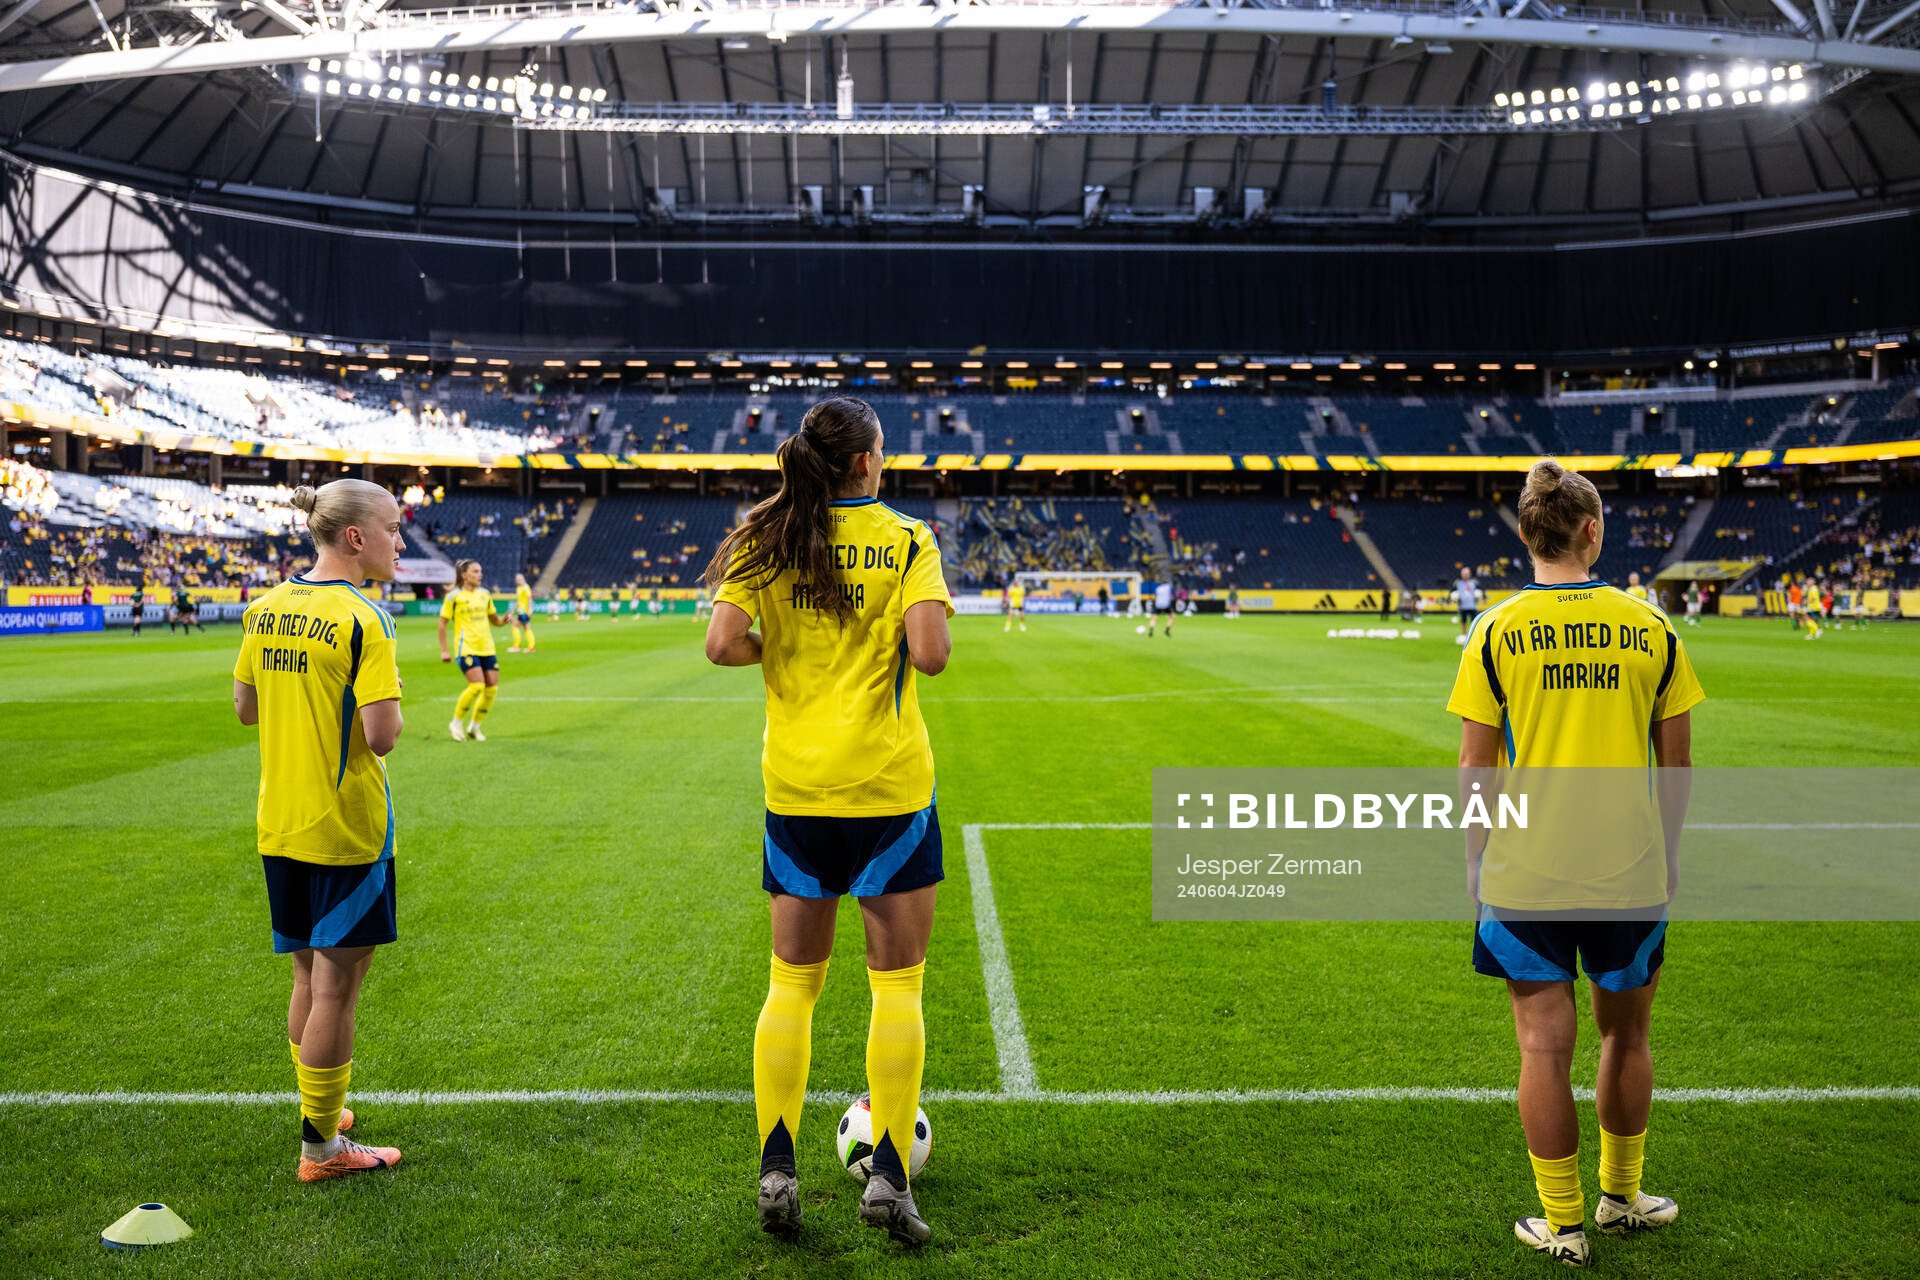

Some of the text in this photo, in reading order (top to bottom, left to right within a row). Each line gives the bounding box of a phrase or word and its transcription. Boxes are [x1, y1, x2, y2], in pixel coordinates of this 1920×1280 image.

[864, 544, 899, 573] DIG,
[1557, 592, 1594, 603] SVERIGE
[36, 611, 84, 628] QUALIFIERS
[256, 607, 276, 635] ÄR
[278, 613, 307, 637] MED
[307, 616, 338, 650] DIG,
[1503, 619, 1654, 658] VI ÄR MED DIG,
[1542, 662, 1620, 690] MARIKA
